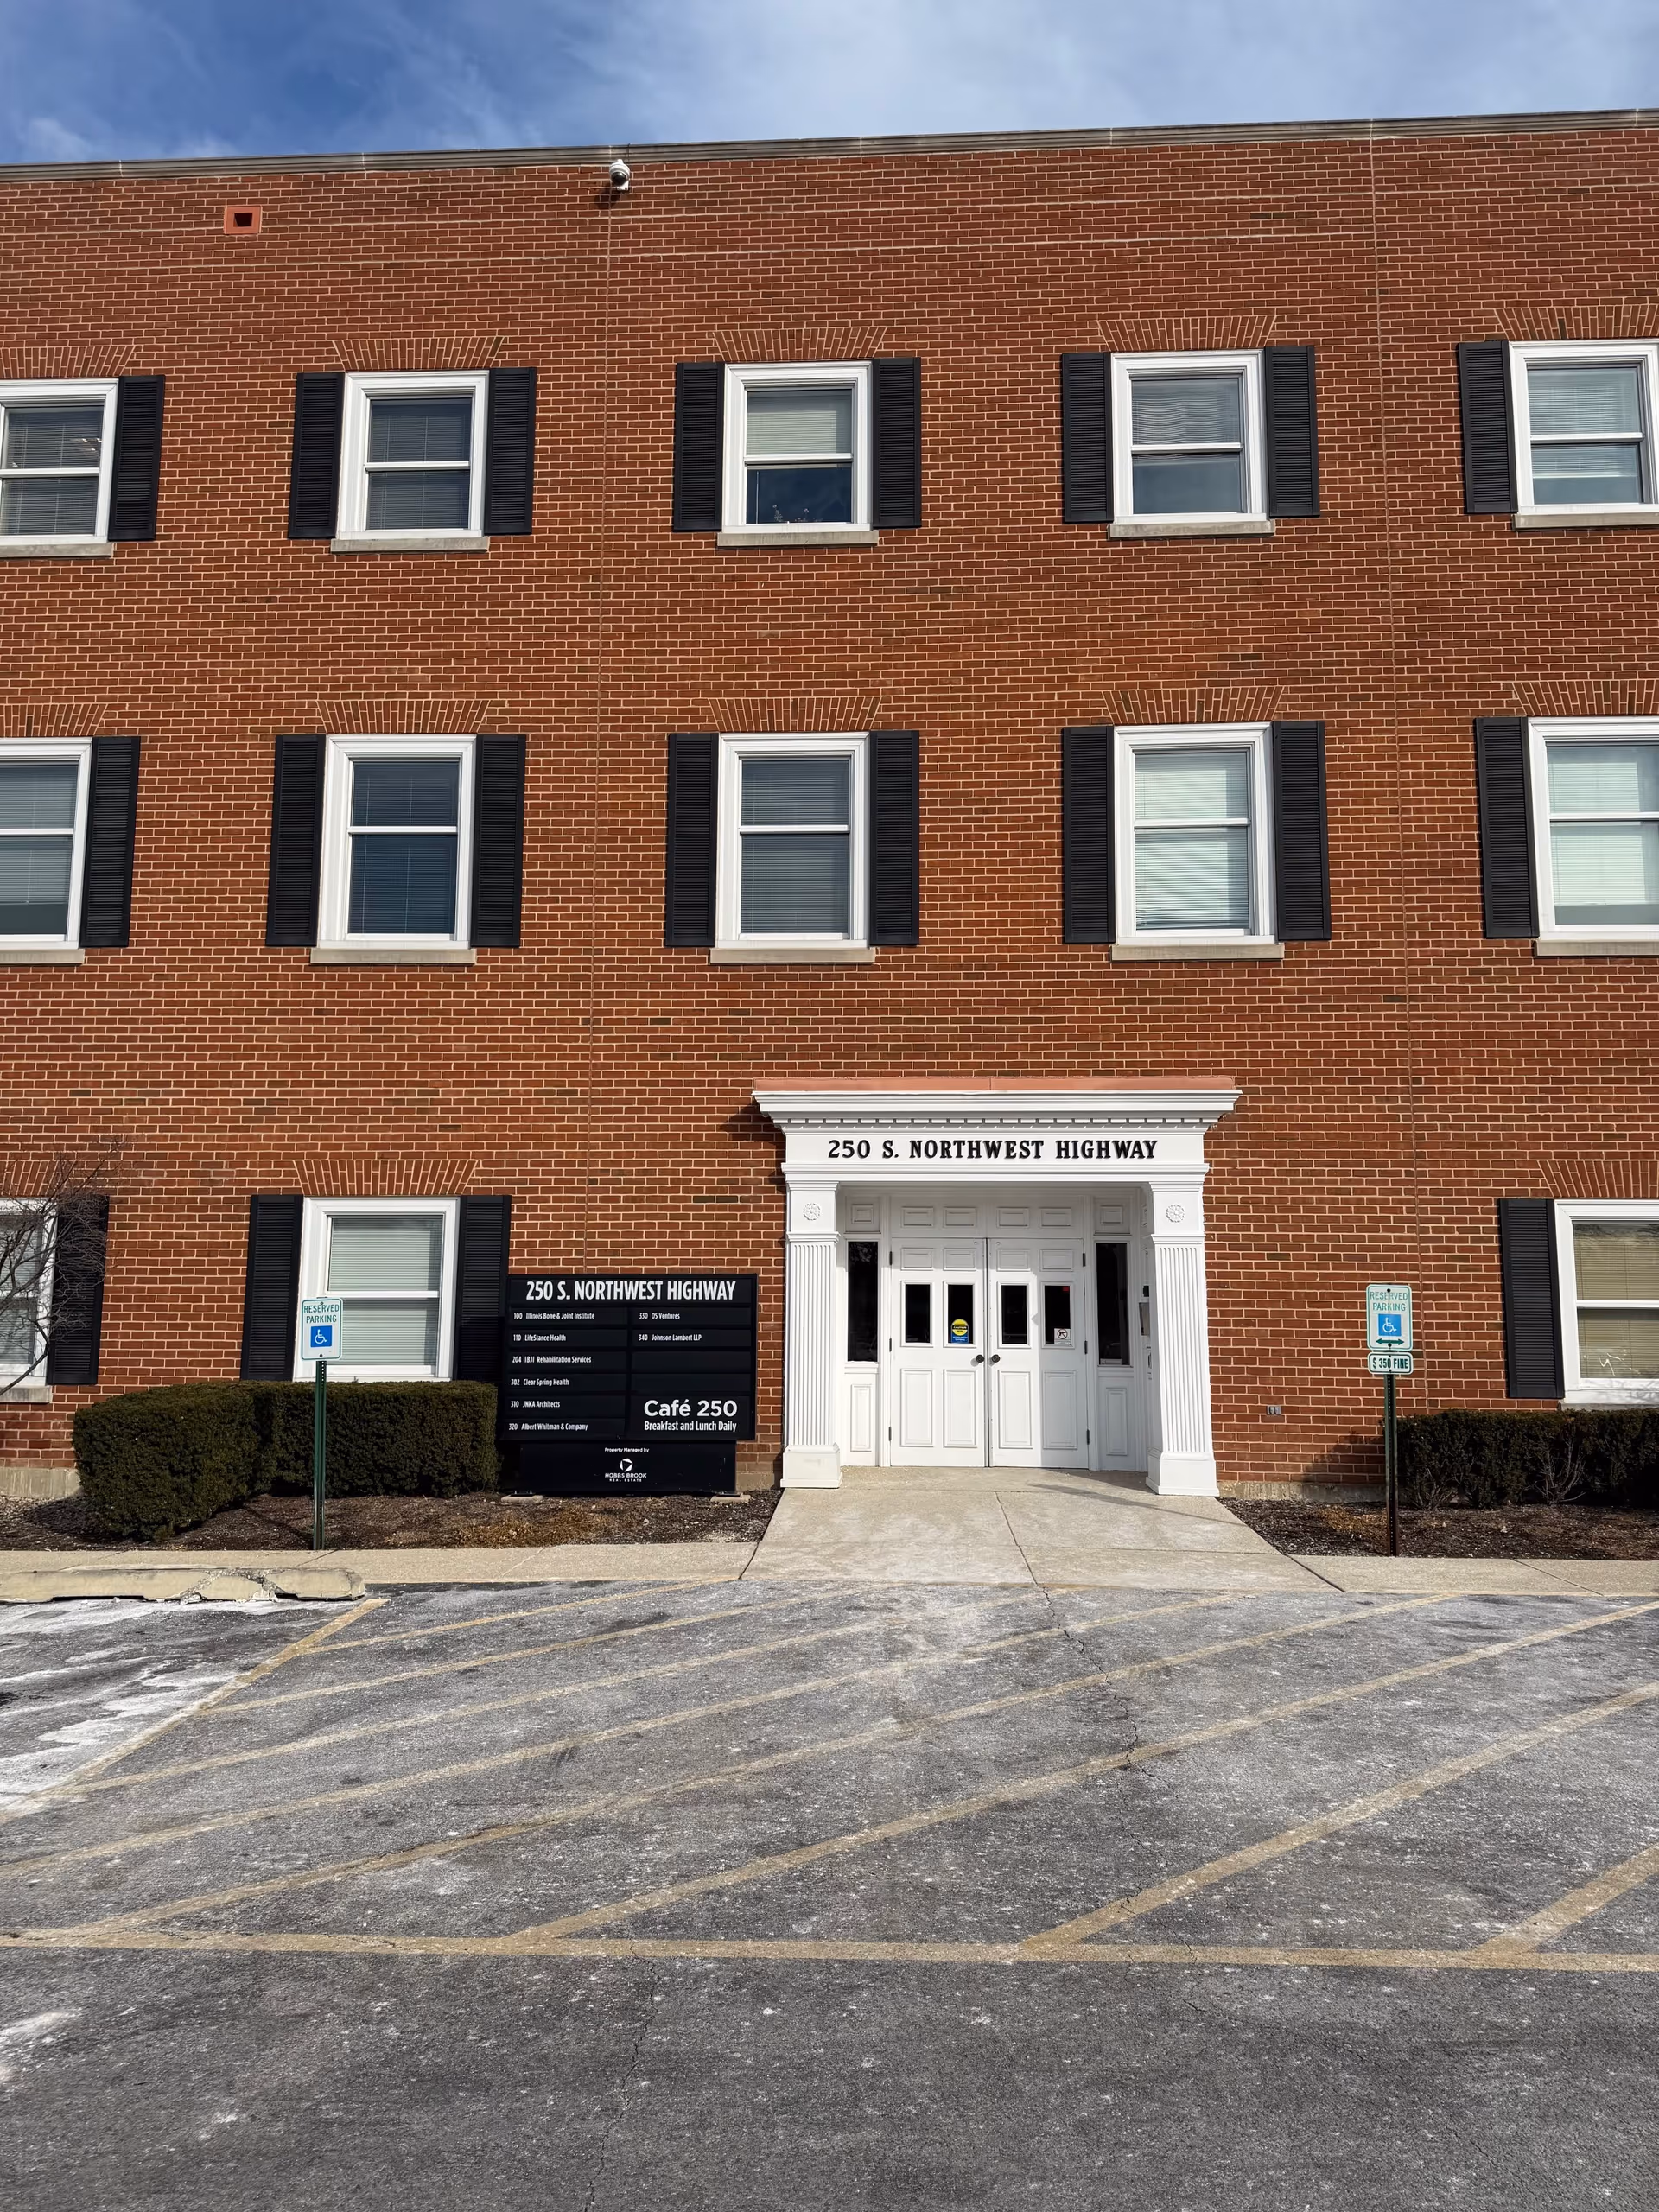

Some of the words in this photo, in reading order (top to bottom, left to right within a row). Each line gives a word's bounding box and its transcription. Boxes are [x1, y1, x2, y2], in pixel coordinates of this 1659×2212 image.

[828, 1139, 871, 1159] 250
[882, 1139, 899, 1159] S.
[910, 1139, 1044, 1159] NORTHWEST
[1056, 1139, 1158, 1159] HIGHWAY
[526, 1281, 553, 1300] 250
[557, 1281, 571, 1300] S.
[574, 1281, 663, 1300] NORTHWEST
[667, 1281, 736, 1300] HIGHWAY
[1370, 1291, 1408, 1300] RESERVED
[304, 1304, 339, 1313] RESERVED
[1373, 1303, 1406, 1311] PARKING
[306, 1315, 337, 1323] PARKING
[1372, 1357, 1377, 1369] $
[1379, 1358, 1391, 1369] 350
[1393, 1358, 1408, 1369] FINE
[644, 1399, 691, 1417] Café
[697, 1400, 738, 1417] 250
[644, 1421, 679, 1430] Breakfast
[680, 1421, 694, 1430] and
[696, 1421, 717, 1430] Lunch
[718, 1421, 737, 1432] Daily
